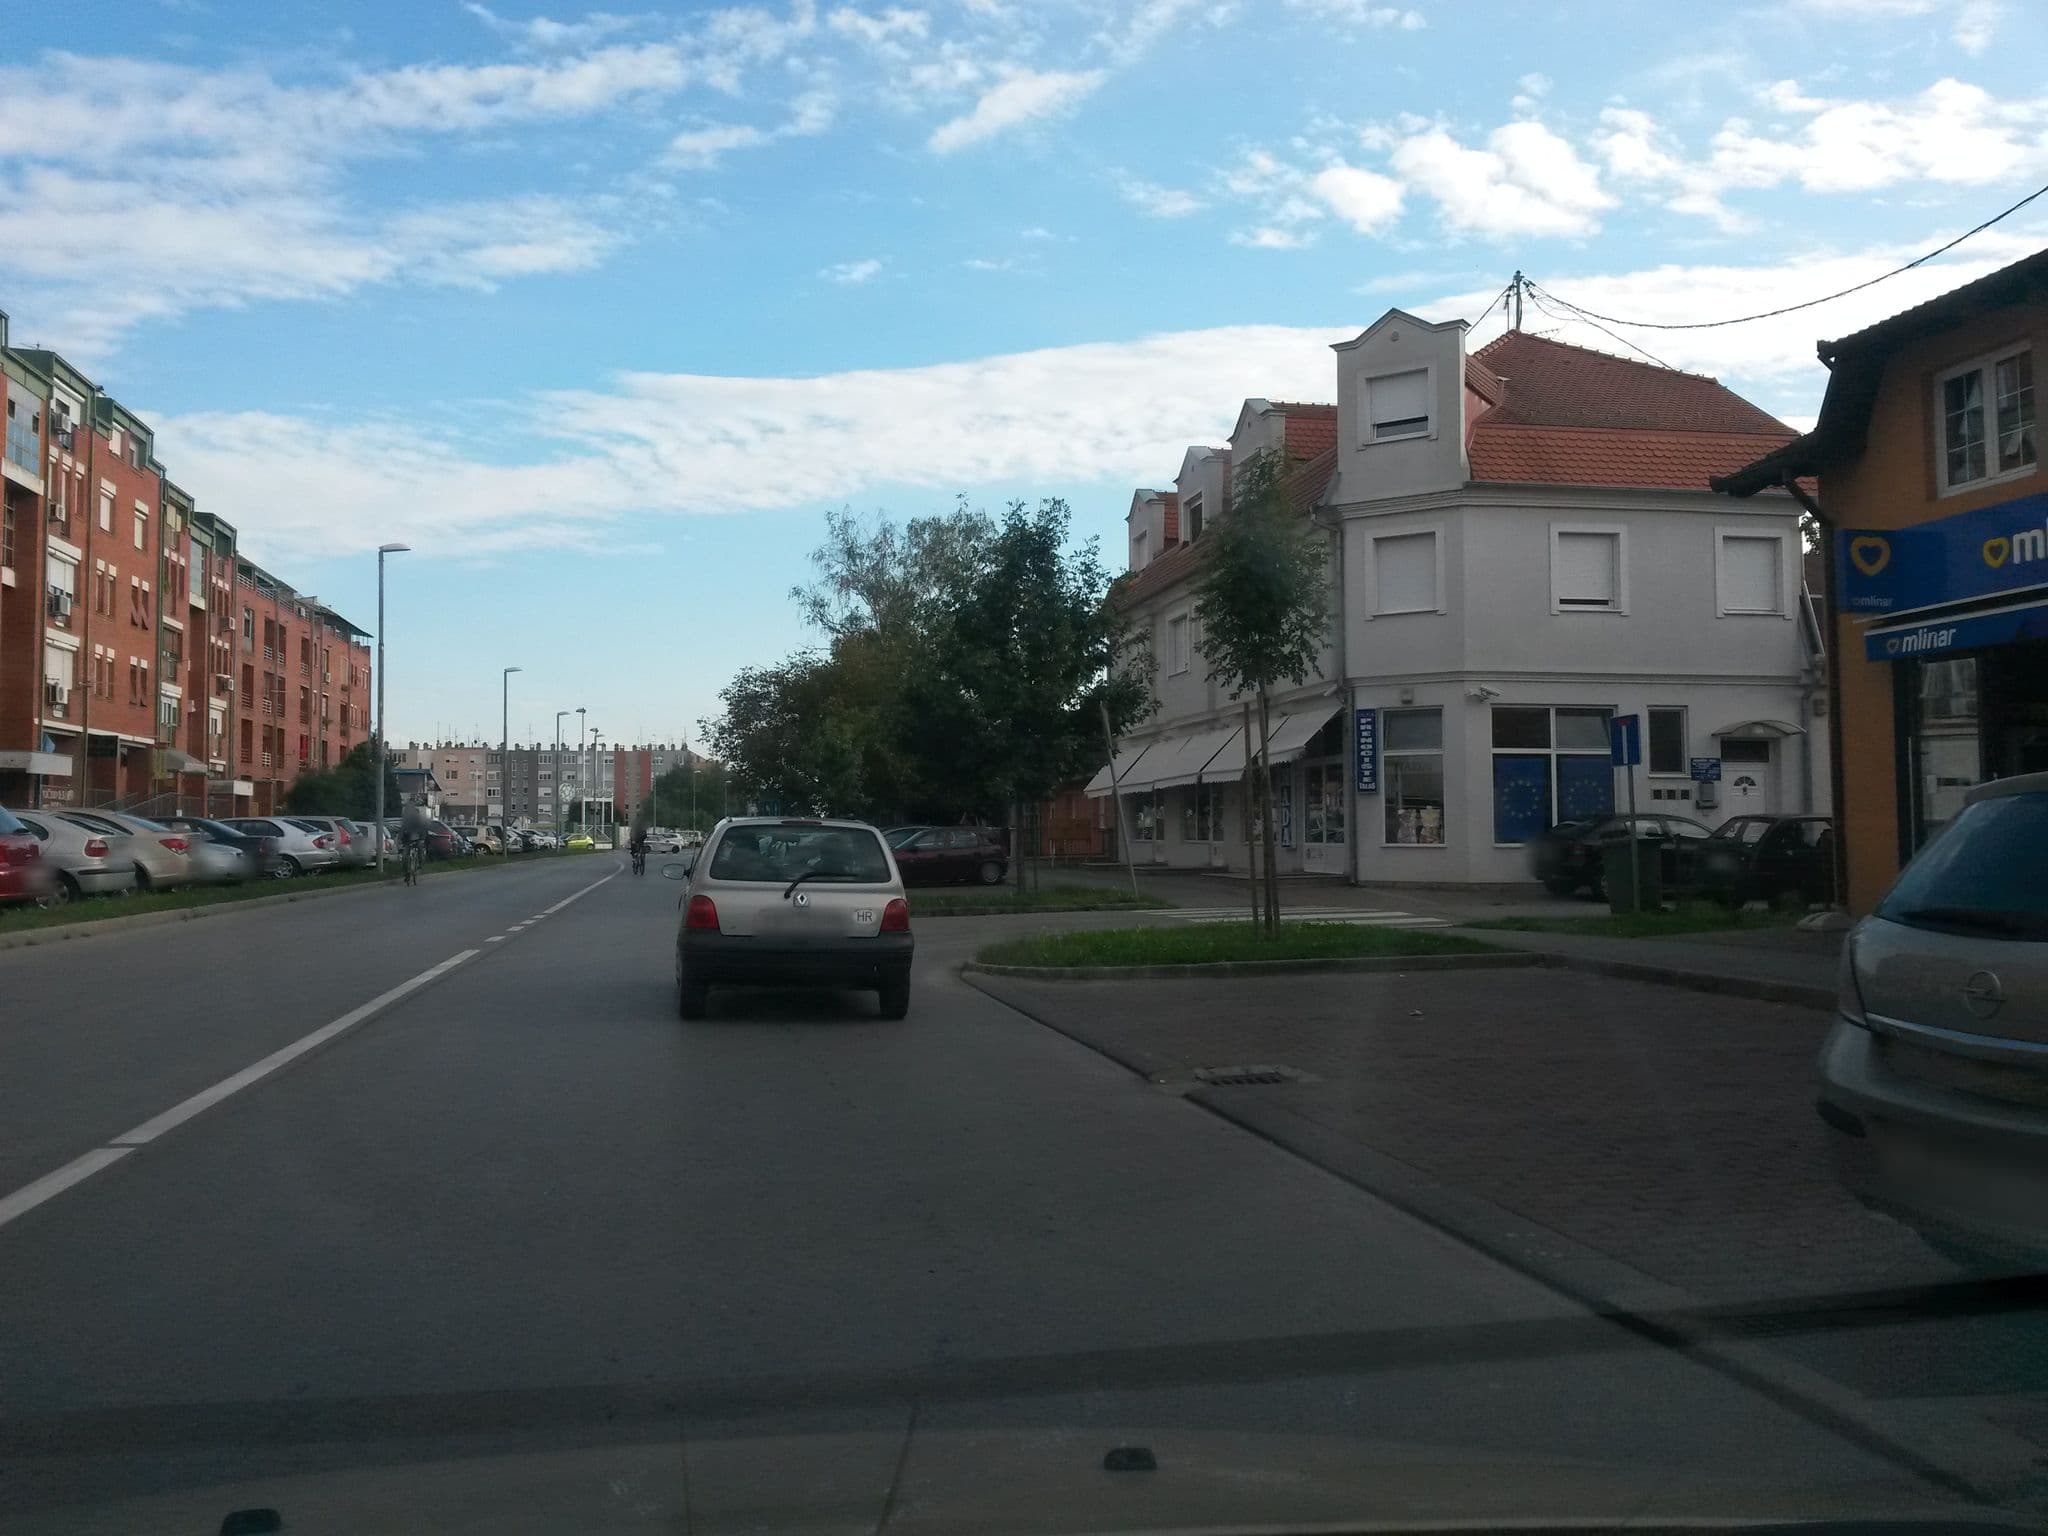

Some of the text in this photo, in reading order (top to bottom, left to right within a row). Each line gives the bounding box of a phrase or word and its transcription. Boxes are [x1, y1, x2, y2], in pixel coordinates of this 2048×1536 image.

[2012, 516, 2048, 565] m
[1861, 594, 1894, 607] mlinar
[1902, 627, 1957, 653] mlinar
[856, 911, 873, 922] HR
